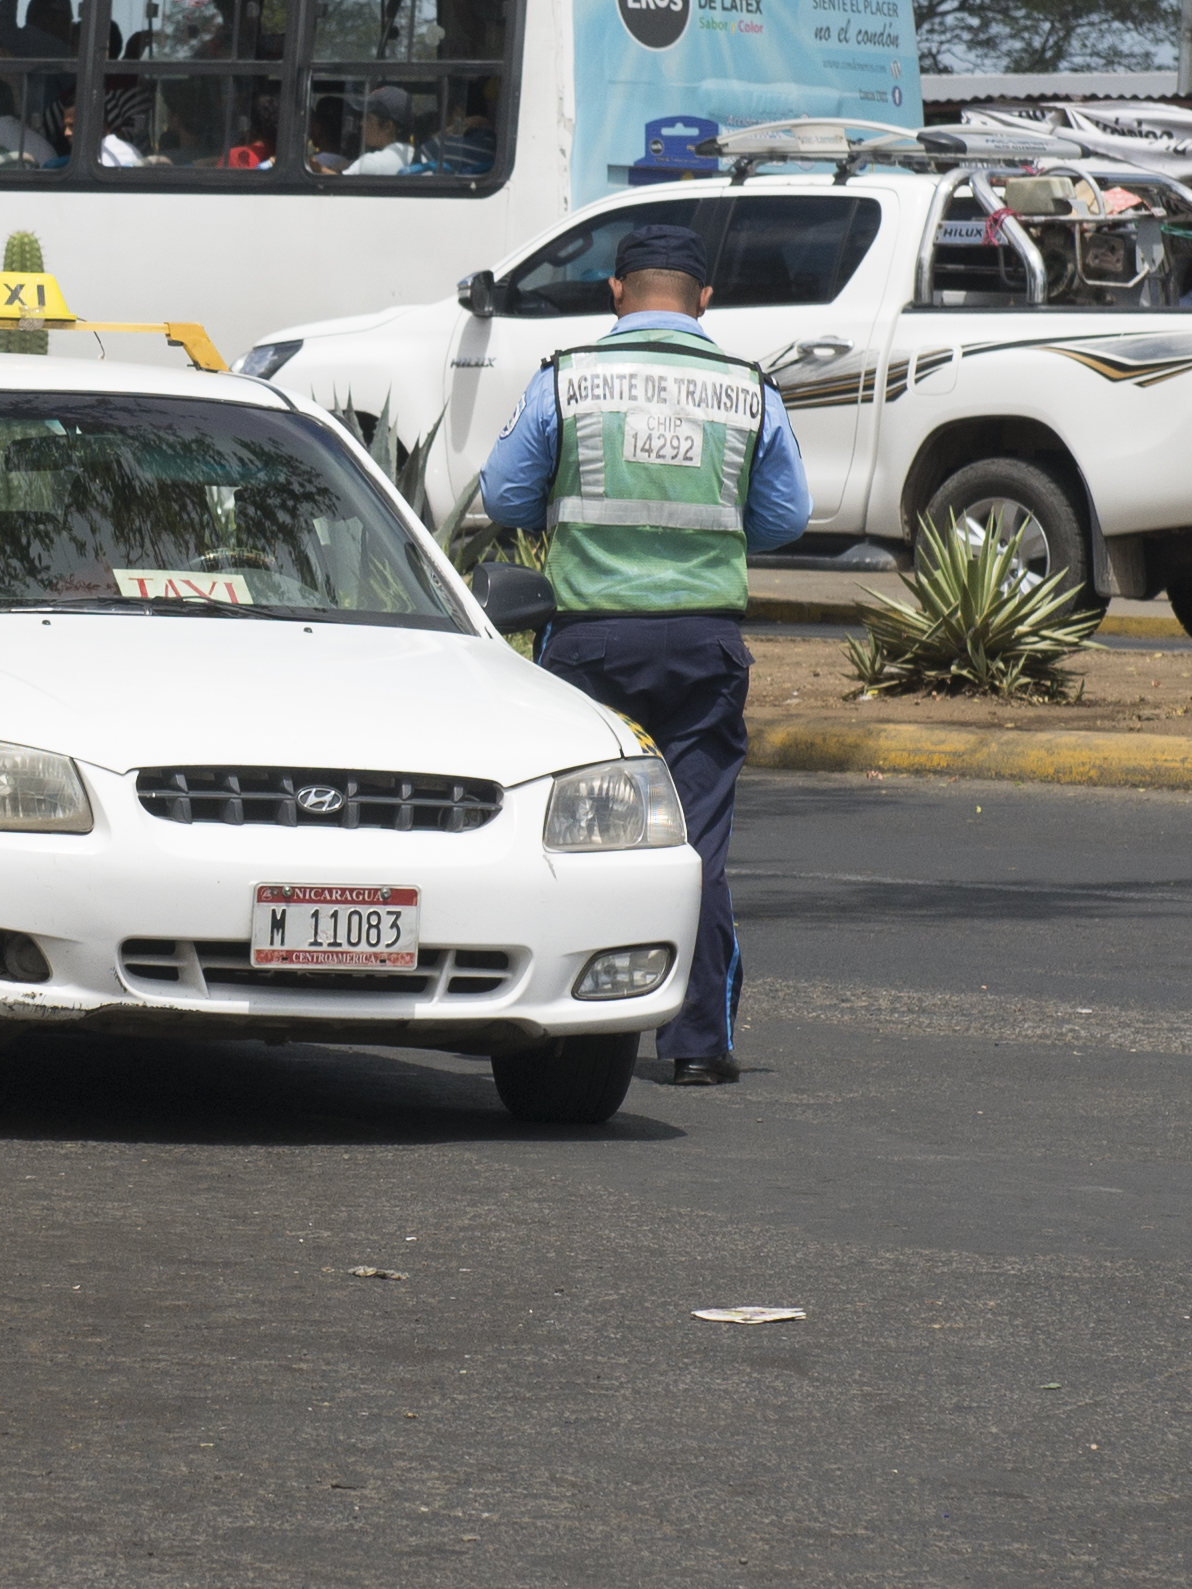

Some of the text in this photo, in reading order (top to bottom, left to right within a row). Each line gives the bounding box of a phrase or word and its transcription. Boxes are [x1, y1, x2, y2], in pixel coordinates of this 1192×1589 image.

[722, 0, 762, 14] LATEX
[812, 0, 899, 18] SIENTE EL PLACER
[699, 17, 728, 30] Sabor
[738, 19, 764, 33] Color
[814, 18, 899, 48] no el condón
[943, 228, 983, 238] HILUX
[566, 373, 760, 420] AGENTE DE TRANSITO
[647, 415, 683, 433] CHIP
[631, 431, 695, 462] 14292
[293, 887, 384, 902] NICARAGUA
[269, 907, 402, 948] M 11083
[292, 951, 377, 964] CENTROAMERICA
